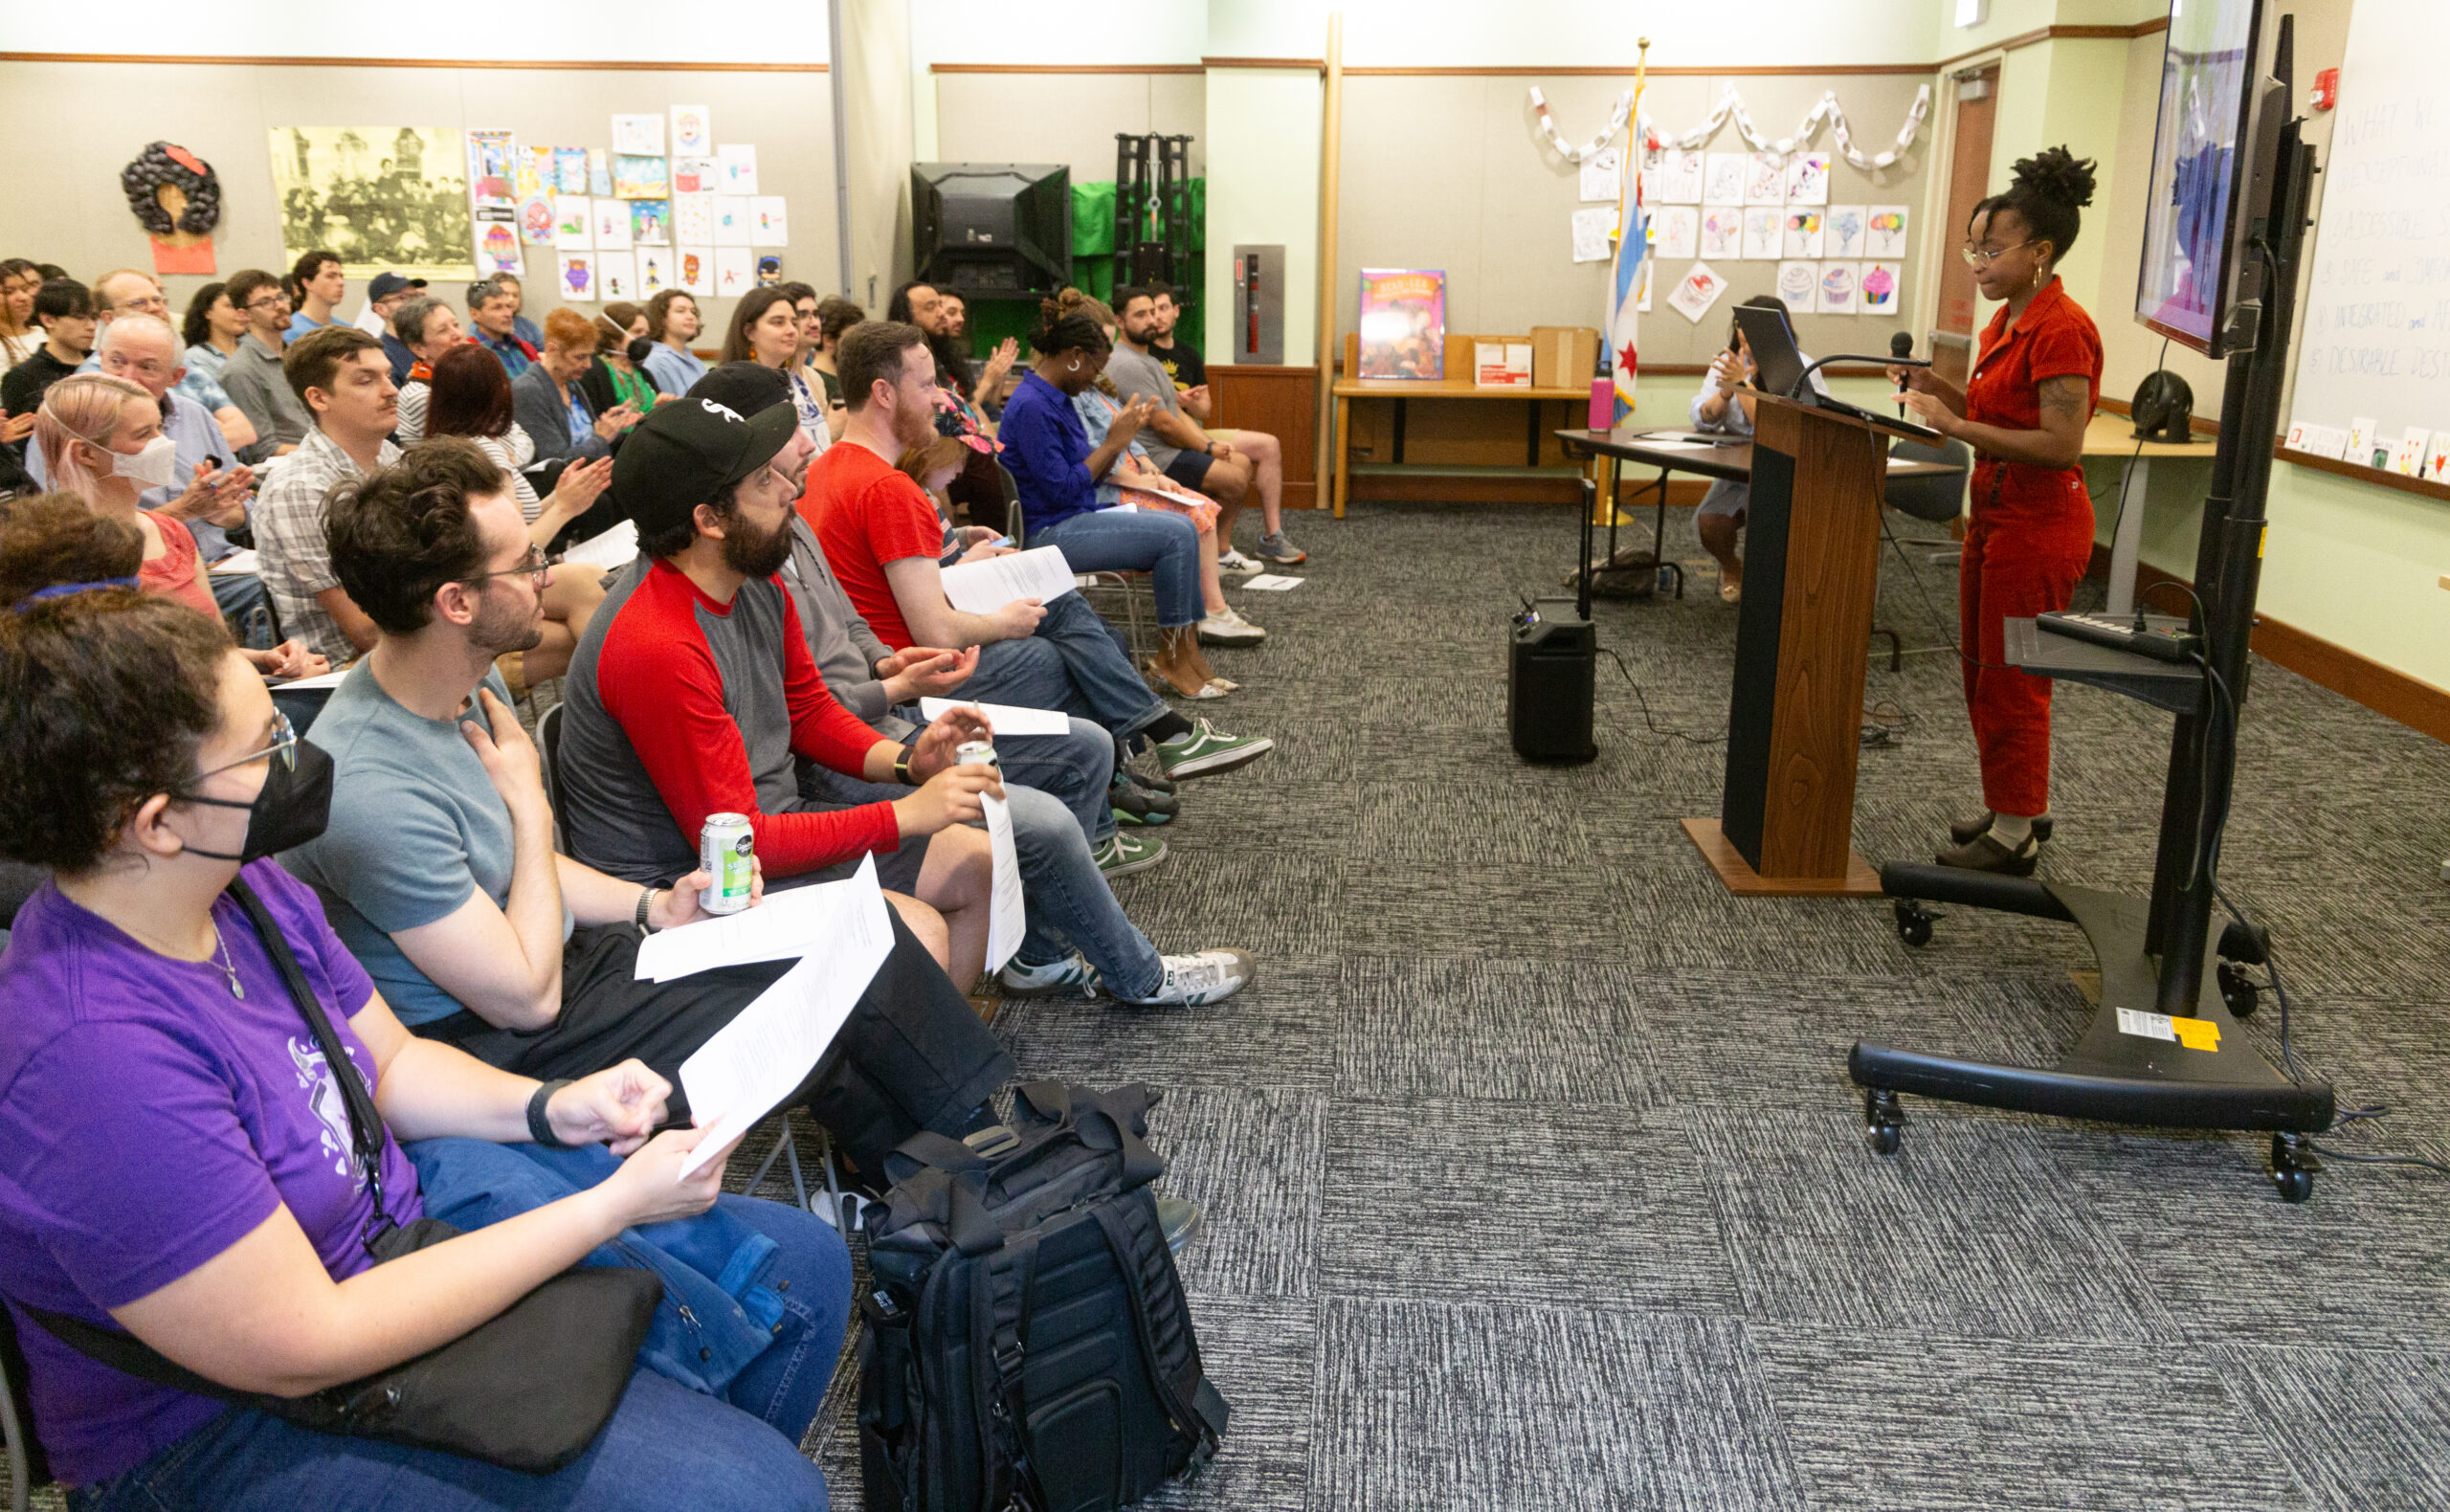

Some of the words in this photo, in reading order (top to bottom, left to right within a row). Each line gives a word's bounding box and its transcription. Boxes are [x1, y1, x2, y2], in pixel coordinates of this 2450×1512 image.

[2344, 100, 2399, 145] WHAT
[2343, 208, 2427, 241] ACCESSIBLE
[2339, 256, 2374, 286] SAFE
[2382, 263, 2401, 281] and
[2335, 300, 2405, 329] INTEGRATED
[2408, 309, 2427, 331] and
[2328, 345, 2400, 375] DESIRABLE
